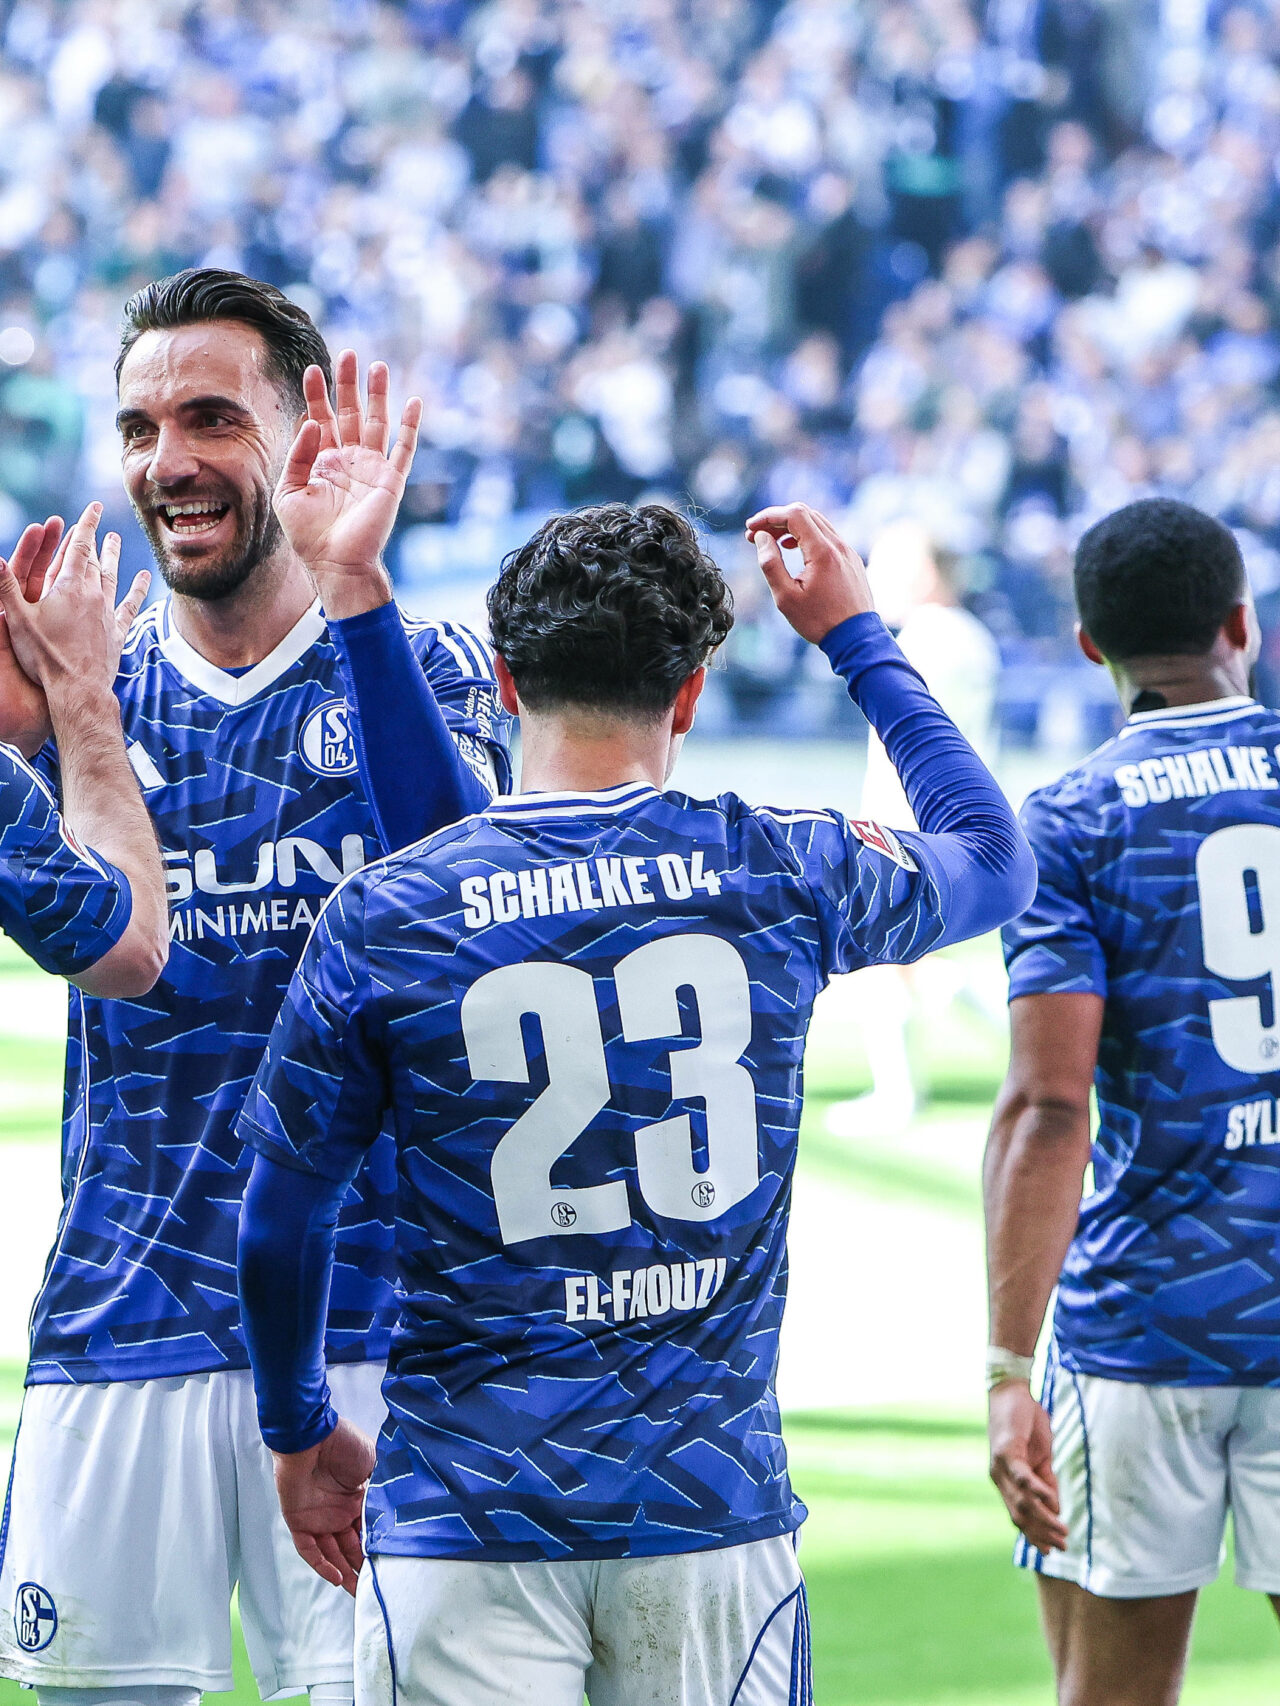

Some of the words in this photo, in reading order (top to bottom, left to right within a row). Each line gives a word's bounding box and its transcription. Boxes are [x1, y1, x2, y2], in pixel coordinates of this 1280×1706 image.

[325, 707, 348, 744] S
[324, 743, 349, 767] 04
[1113, 745, 1280, 808] SCHALKE
[459, 856, 656, 929] SCHALKE
[656, 851, 722, 900] 04
[1195, 823, 1280, 1074] 9
[461, 933, 760, 1245] 23
[1224, 1098, 1280, 1151] SYL
[22, 1588, 38, 1623] S
[22, 1621, 37, 1646] 04
